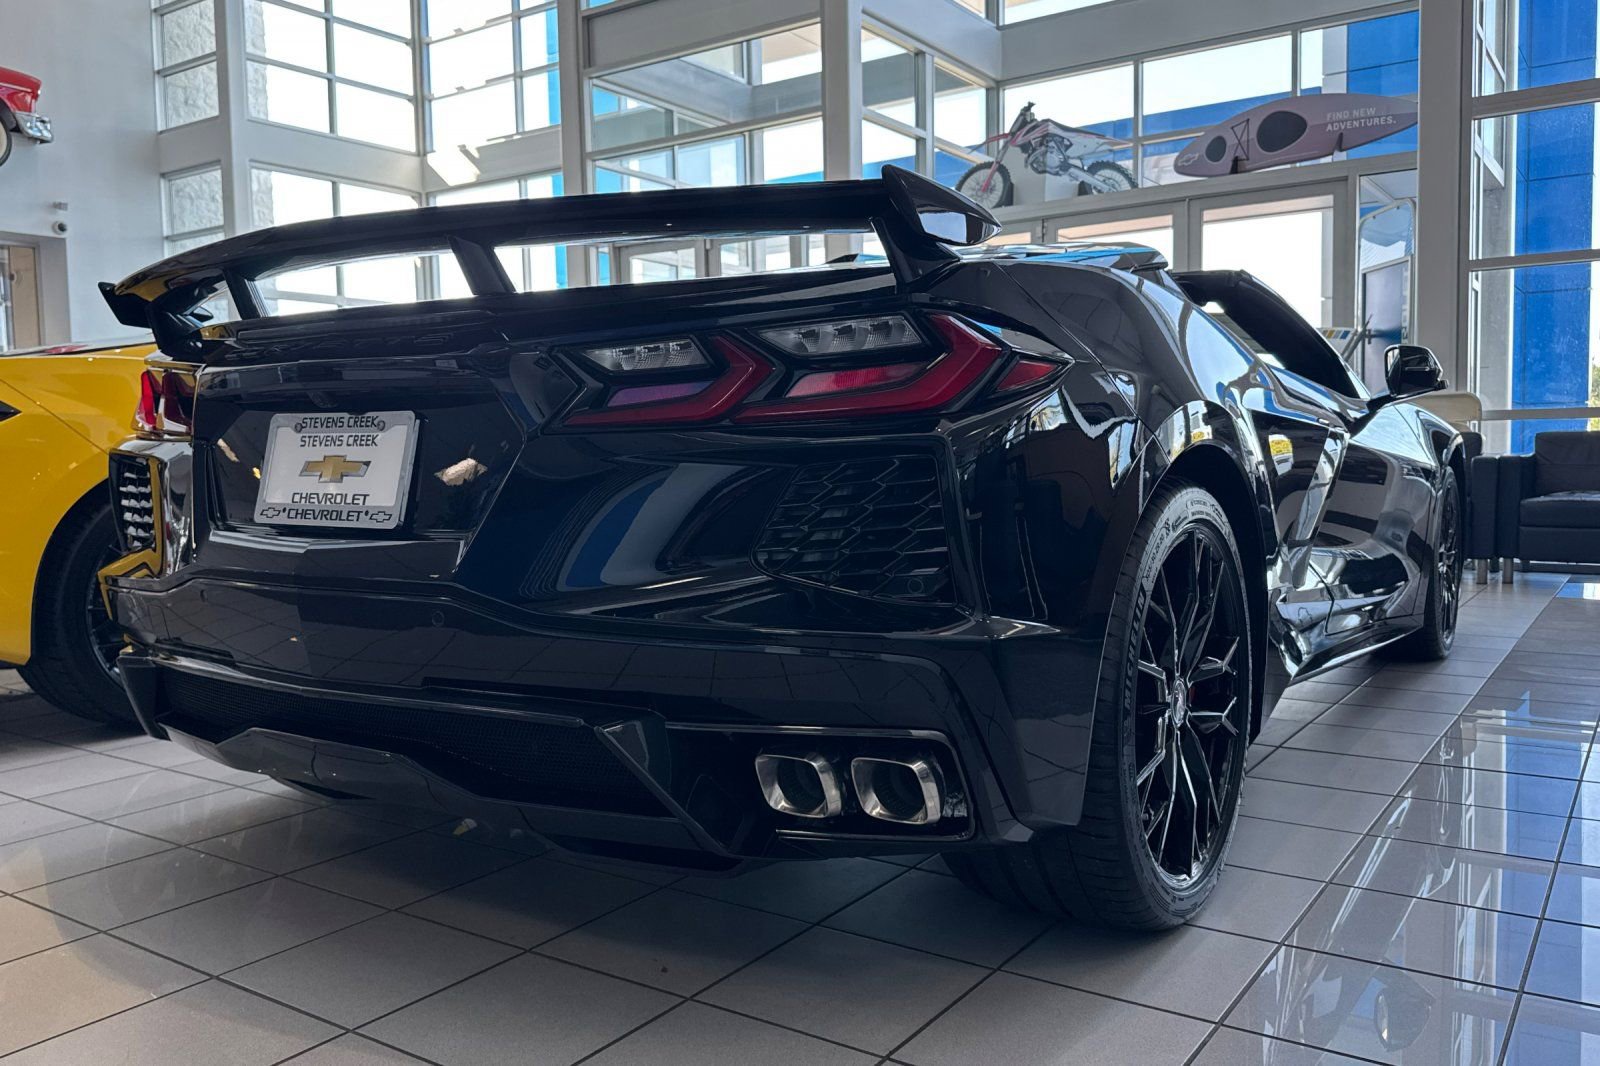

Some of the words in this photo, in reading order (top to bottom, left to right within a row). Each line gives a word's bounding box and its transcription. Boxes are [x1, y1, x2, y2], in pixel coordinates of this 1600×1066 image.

[1327, 111, 1349, 121] FIND
[1353, 108, 1376, 118] NEW
[1326, 116, 1397, 131] ADVENTURES.
[301, 416, 345, 429] STEVENS
[347, 415, 379, 428] CREEK
[300, 434, 344, 448] STEVENS
[346, 433, 379, 447] CREEK
[291, 492, 370, 506] CHEVROLET
[287, 508, 363, 522] CHEVROLET
[1124, 591, 1145, 710] MICHELIN
